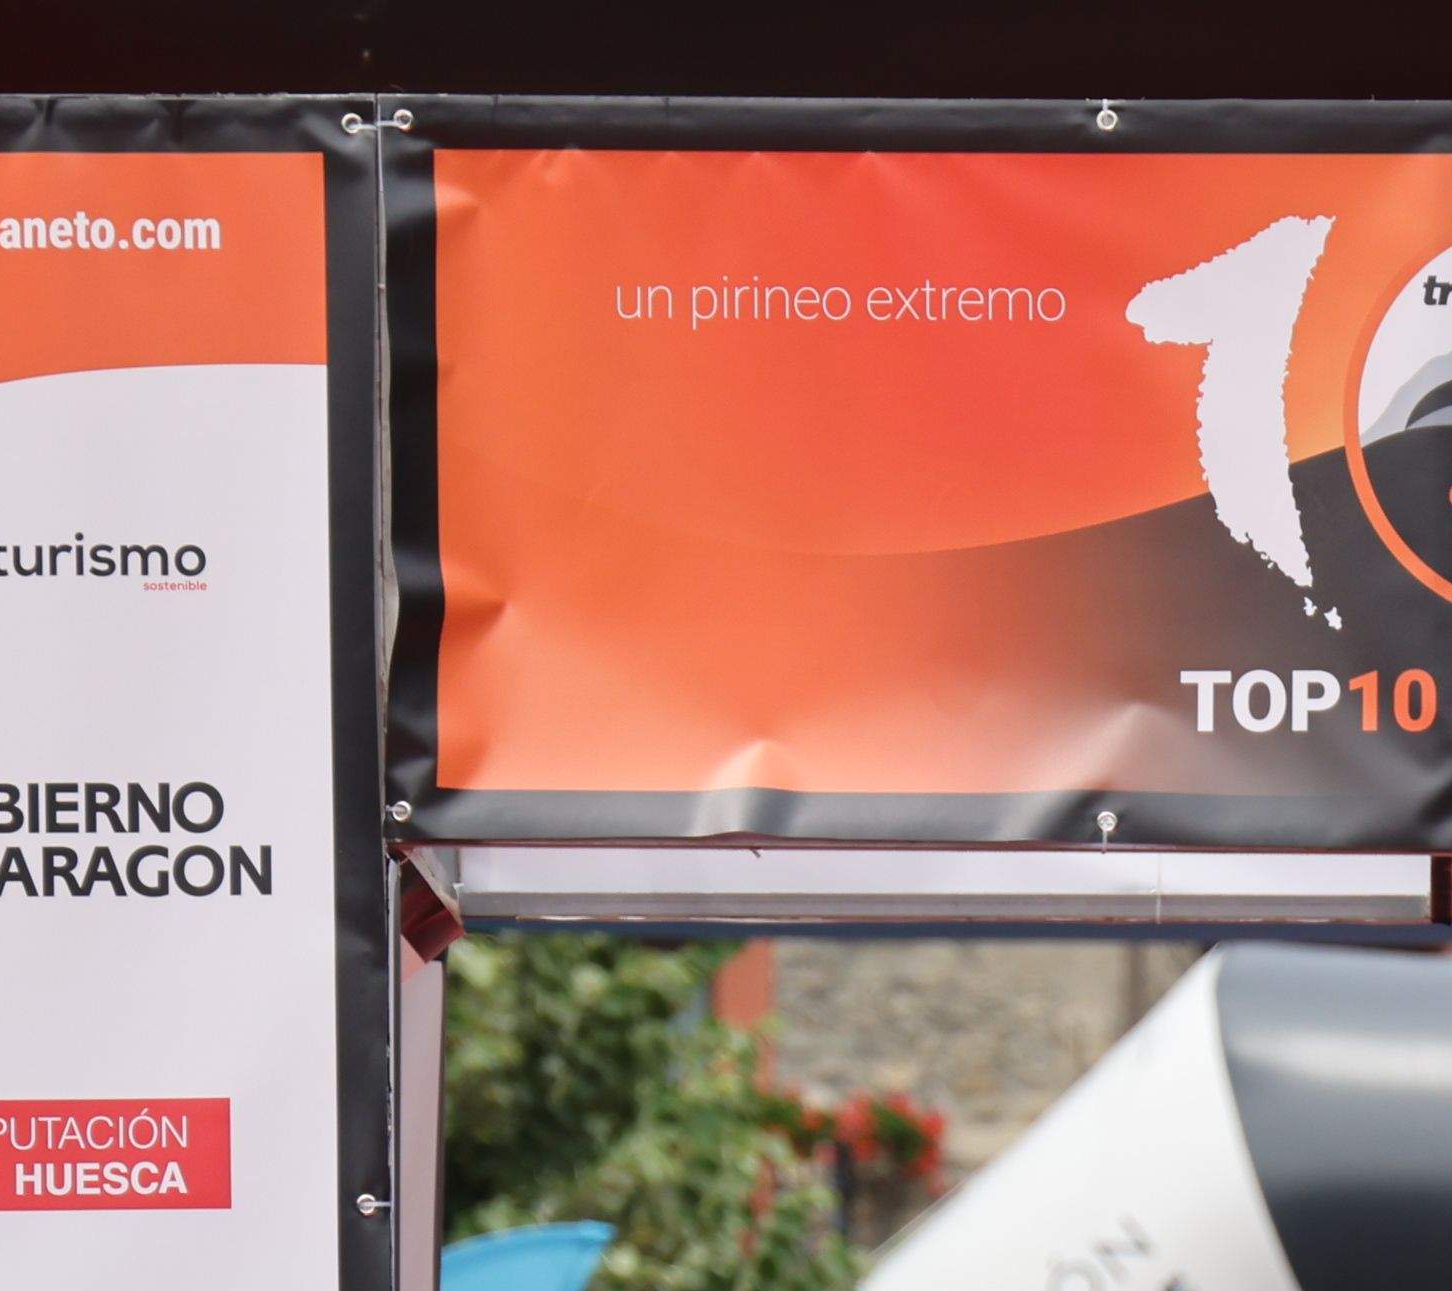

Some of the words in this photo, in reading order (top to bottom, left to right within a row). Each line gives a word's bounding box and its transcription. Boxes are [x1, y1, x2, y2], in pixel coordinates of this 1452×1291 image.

[616, 282, 673, 319] un
[691, 276, 852, 330] pirineo
[866, 280, 1066, 321] extremo
[143, 579, 208, 592] sostenible
[16, 1161, 188, 1196] HUESCA
